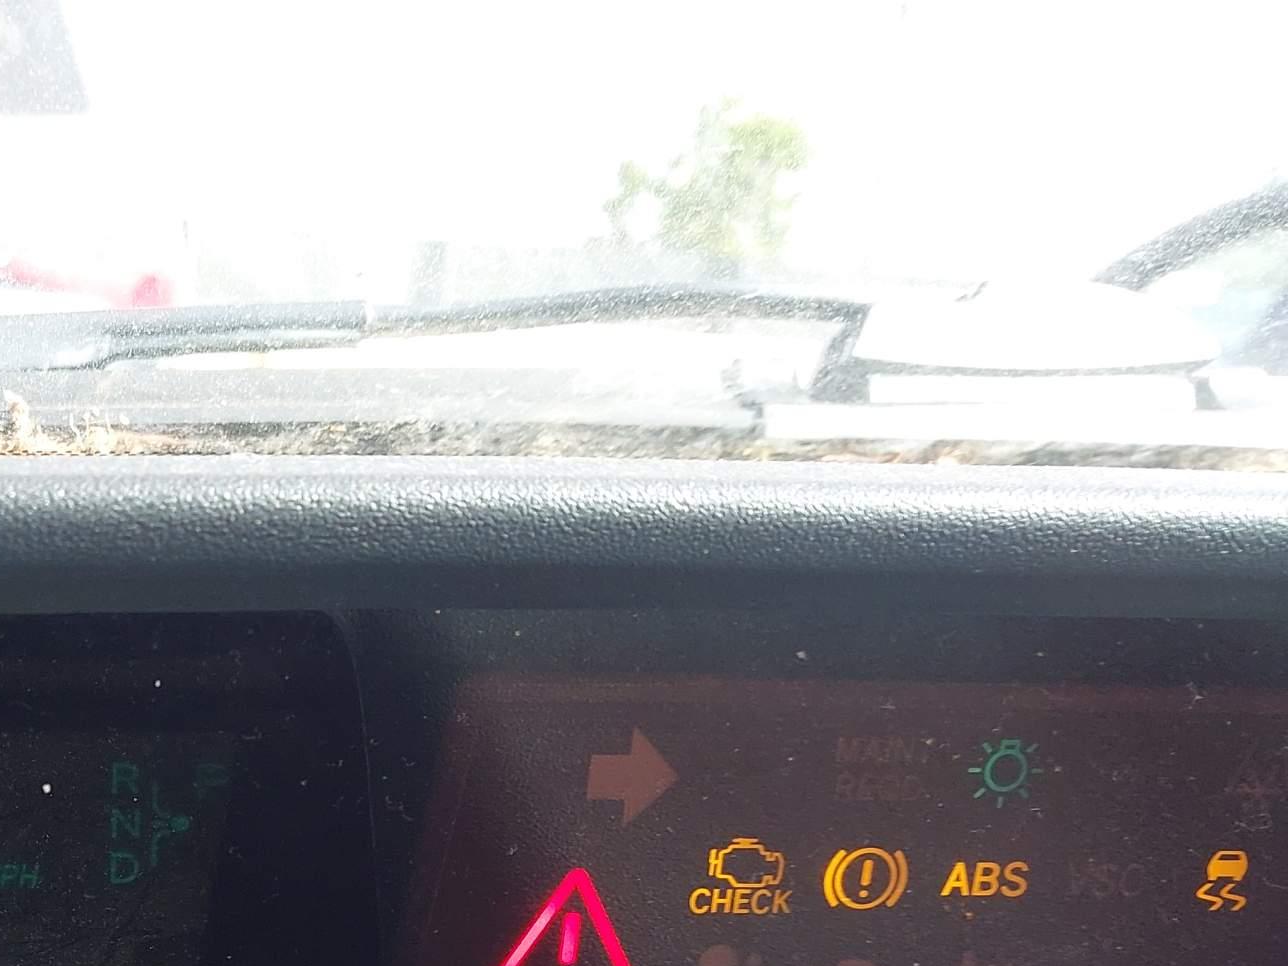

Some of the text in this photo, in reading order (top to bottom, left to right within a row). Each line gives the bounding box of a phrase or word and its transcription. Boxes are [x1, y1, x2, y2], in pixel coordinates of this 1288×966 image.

[111, 762, 139, 794] R
[110, 808, 141, 838] N
[109, 850, 139, 885] D
[940, 860, 1031, 898] ABS
[688, 887, 793, 916] CHECK
